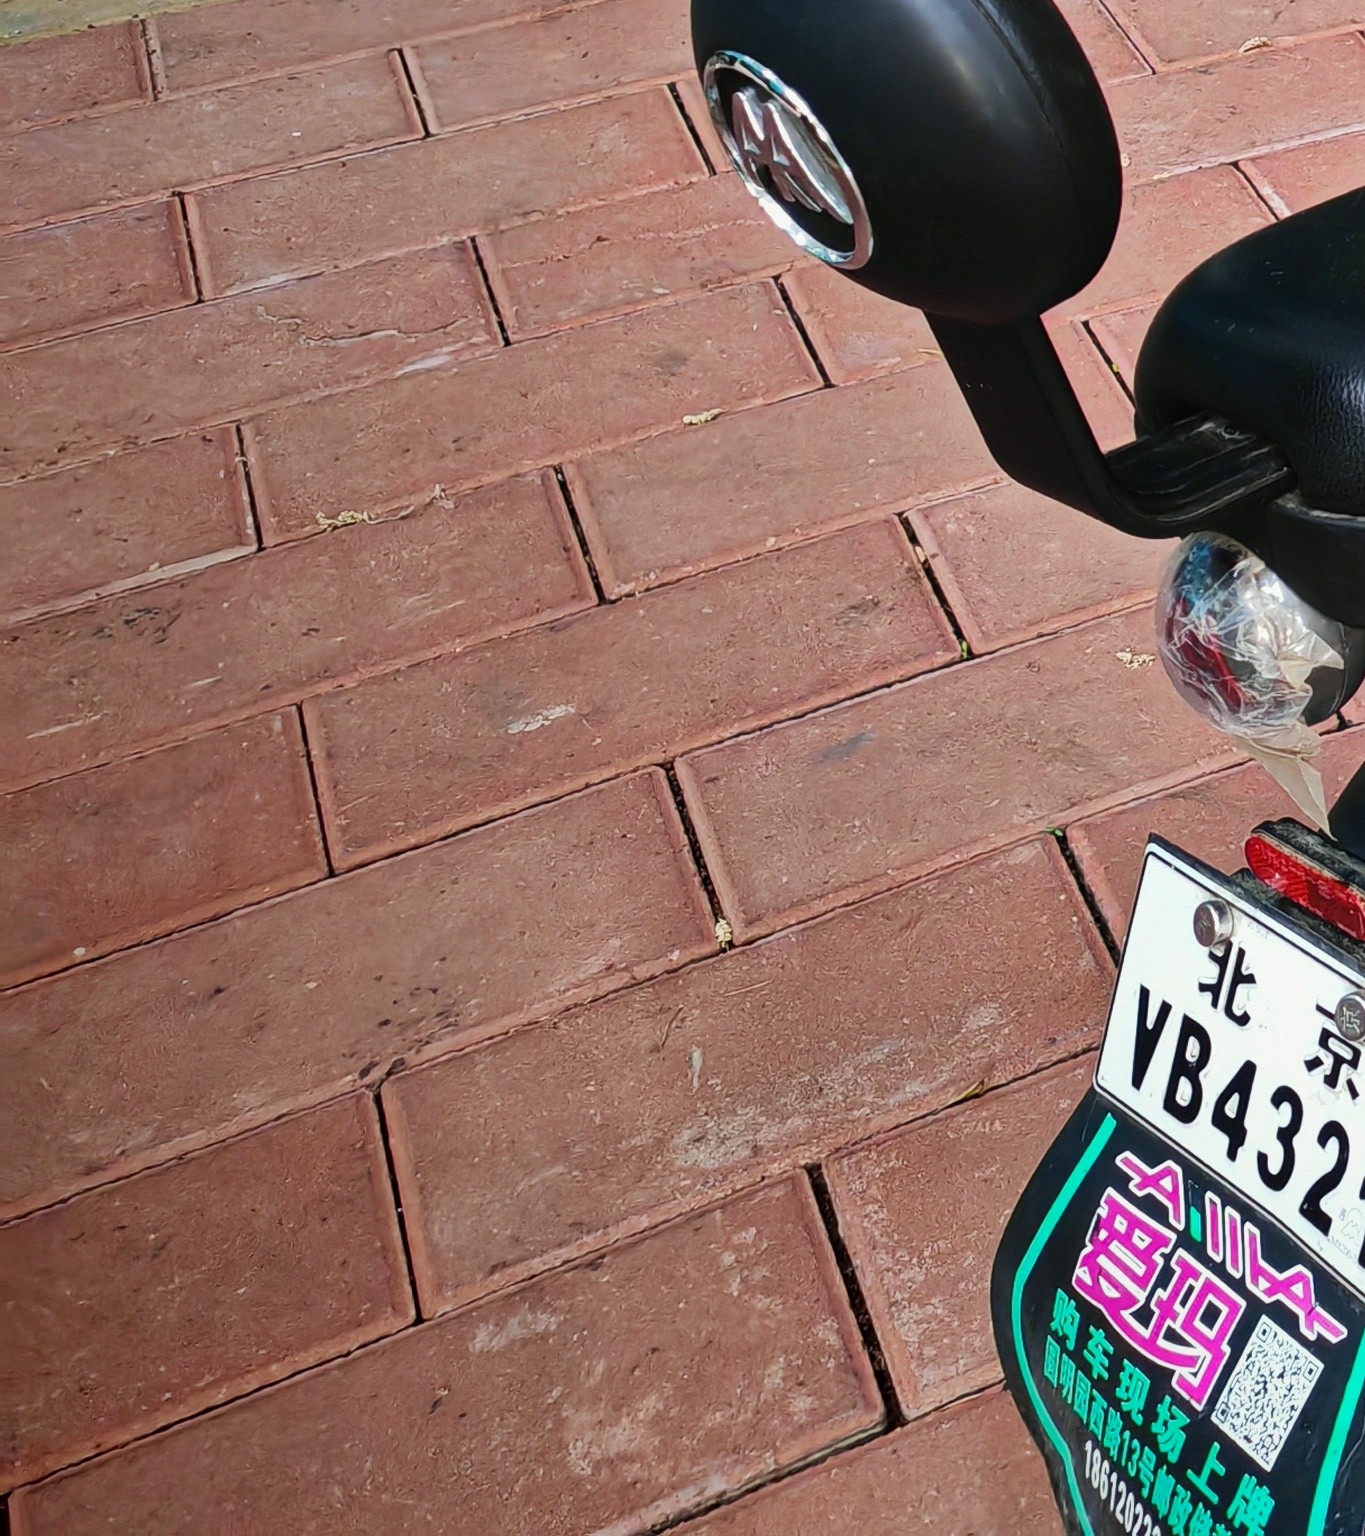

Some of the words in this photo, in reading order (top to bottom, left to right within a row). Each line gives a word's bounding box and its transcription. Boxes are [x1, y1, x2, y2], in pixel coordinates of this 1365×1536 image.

[1050, 1287, 1275, 1536] 购车现场上牌
[1072, 1186, 1247, 1412] 爱玛
